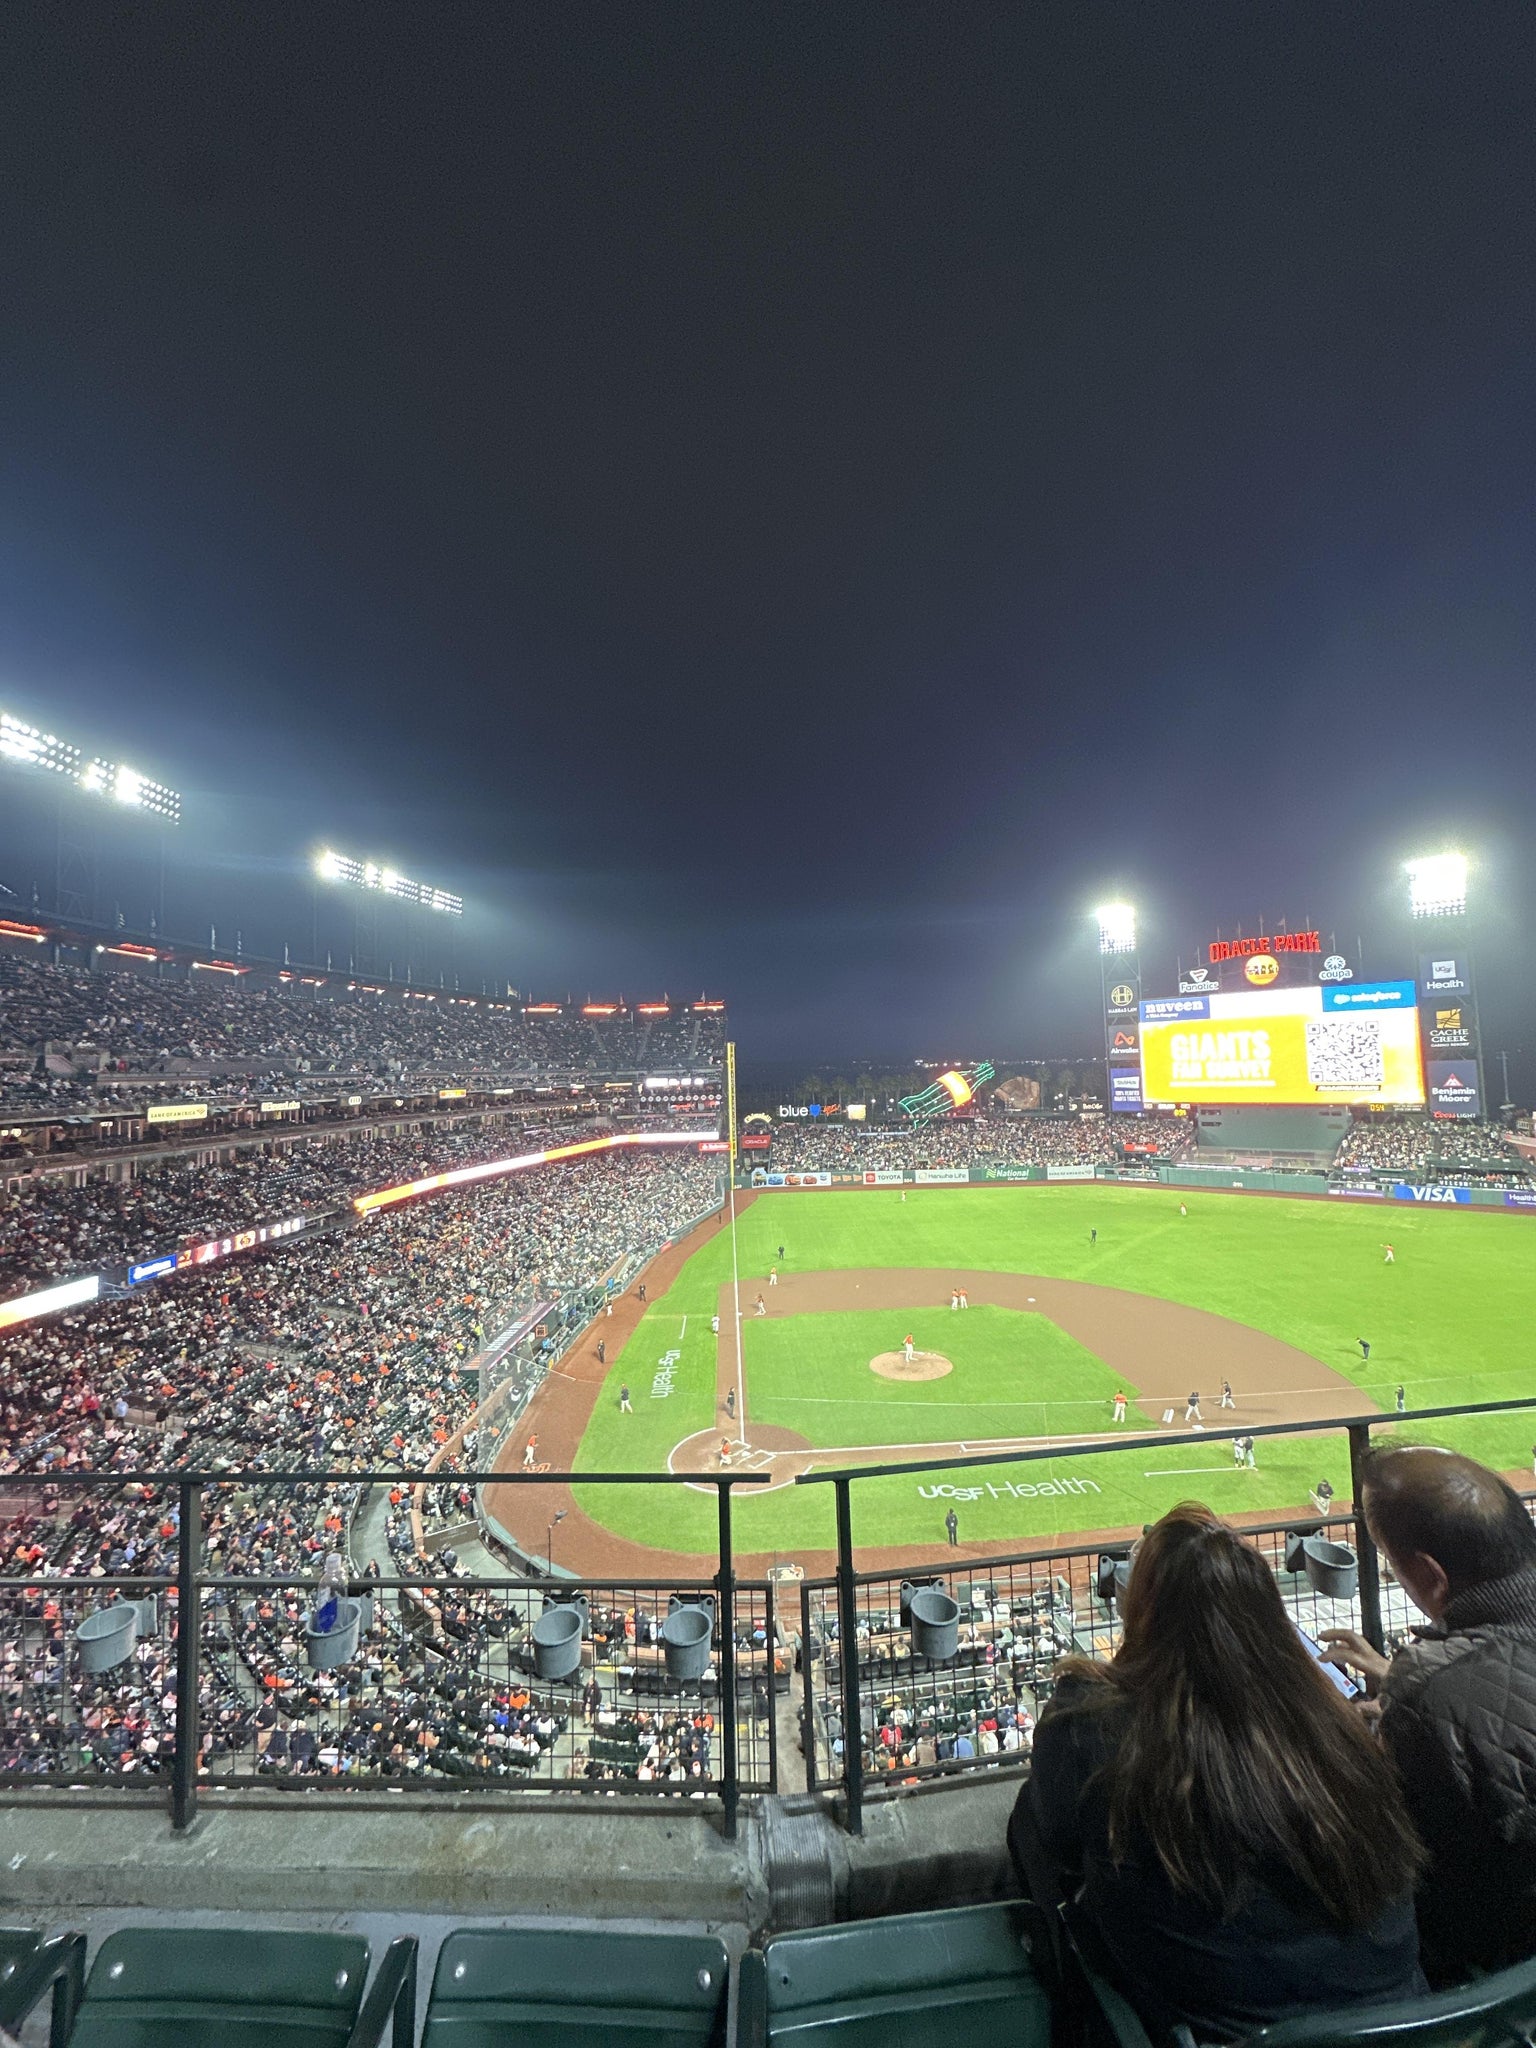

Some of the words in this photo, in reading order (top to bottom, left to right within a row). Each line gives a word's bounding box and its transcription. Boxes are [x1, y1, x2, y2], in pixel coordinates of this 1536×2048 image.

[1209, 937, 1270, 963] ORACLE
[1274, 931, 1321, 953] PARK
[1320, 968, 1352, 980] coupa
[1180, 981, 1219, 993] Fanatics
[1426, 980, 1464, 990] Health
[1146, 1000, 1203, 1013] nuveen
[1430, 1028, 1469, 1036] CACHE
[1431, 1035, 1468, 1043] CREEK
[1170, 1030, 1271, 1061] GIANTS
[1207, 1059, 1271, 1078] SURVEY
[1432, 1087, 1476, 1096] Benjamin
[780, 1105, 808, 1117] blue
[1434, 1110, 1456, 1118] Coors
[996, 1169, 1029, 1178] National
[1409, 1187, 1457, 1202] VISA
[650, 1366, 679, 1398] Health
[917, 1484, 984, 1500] UCSF
[986, 1476, 1102, 1499] Health
